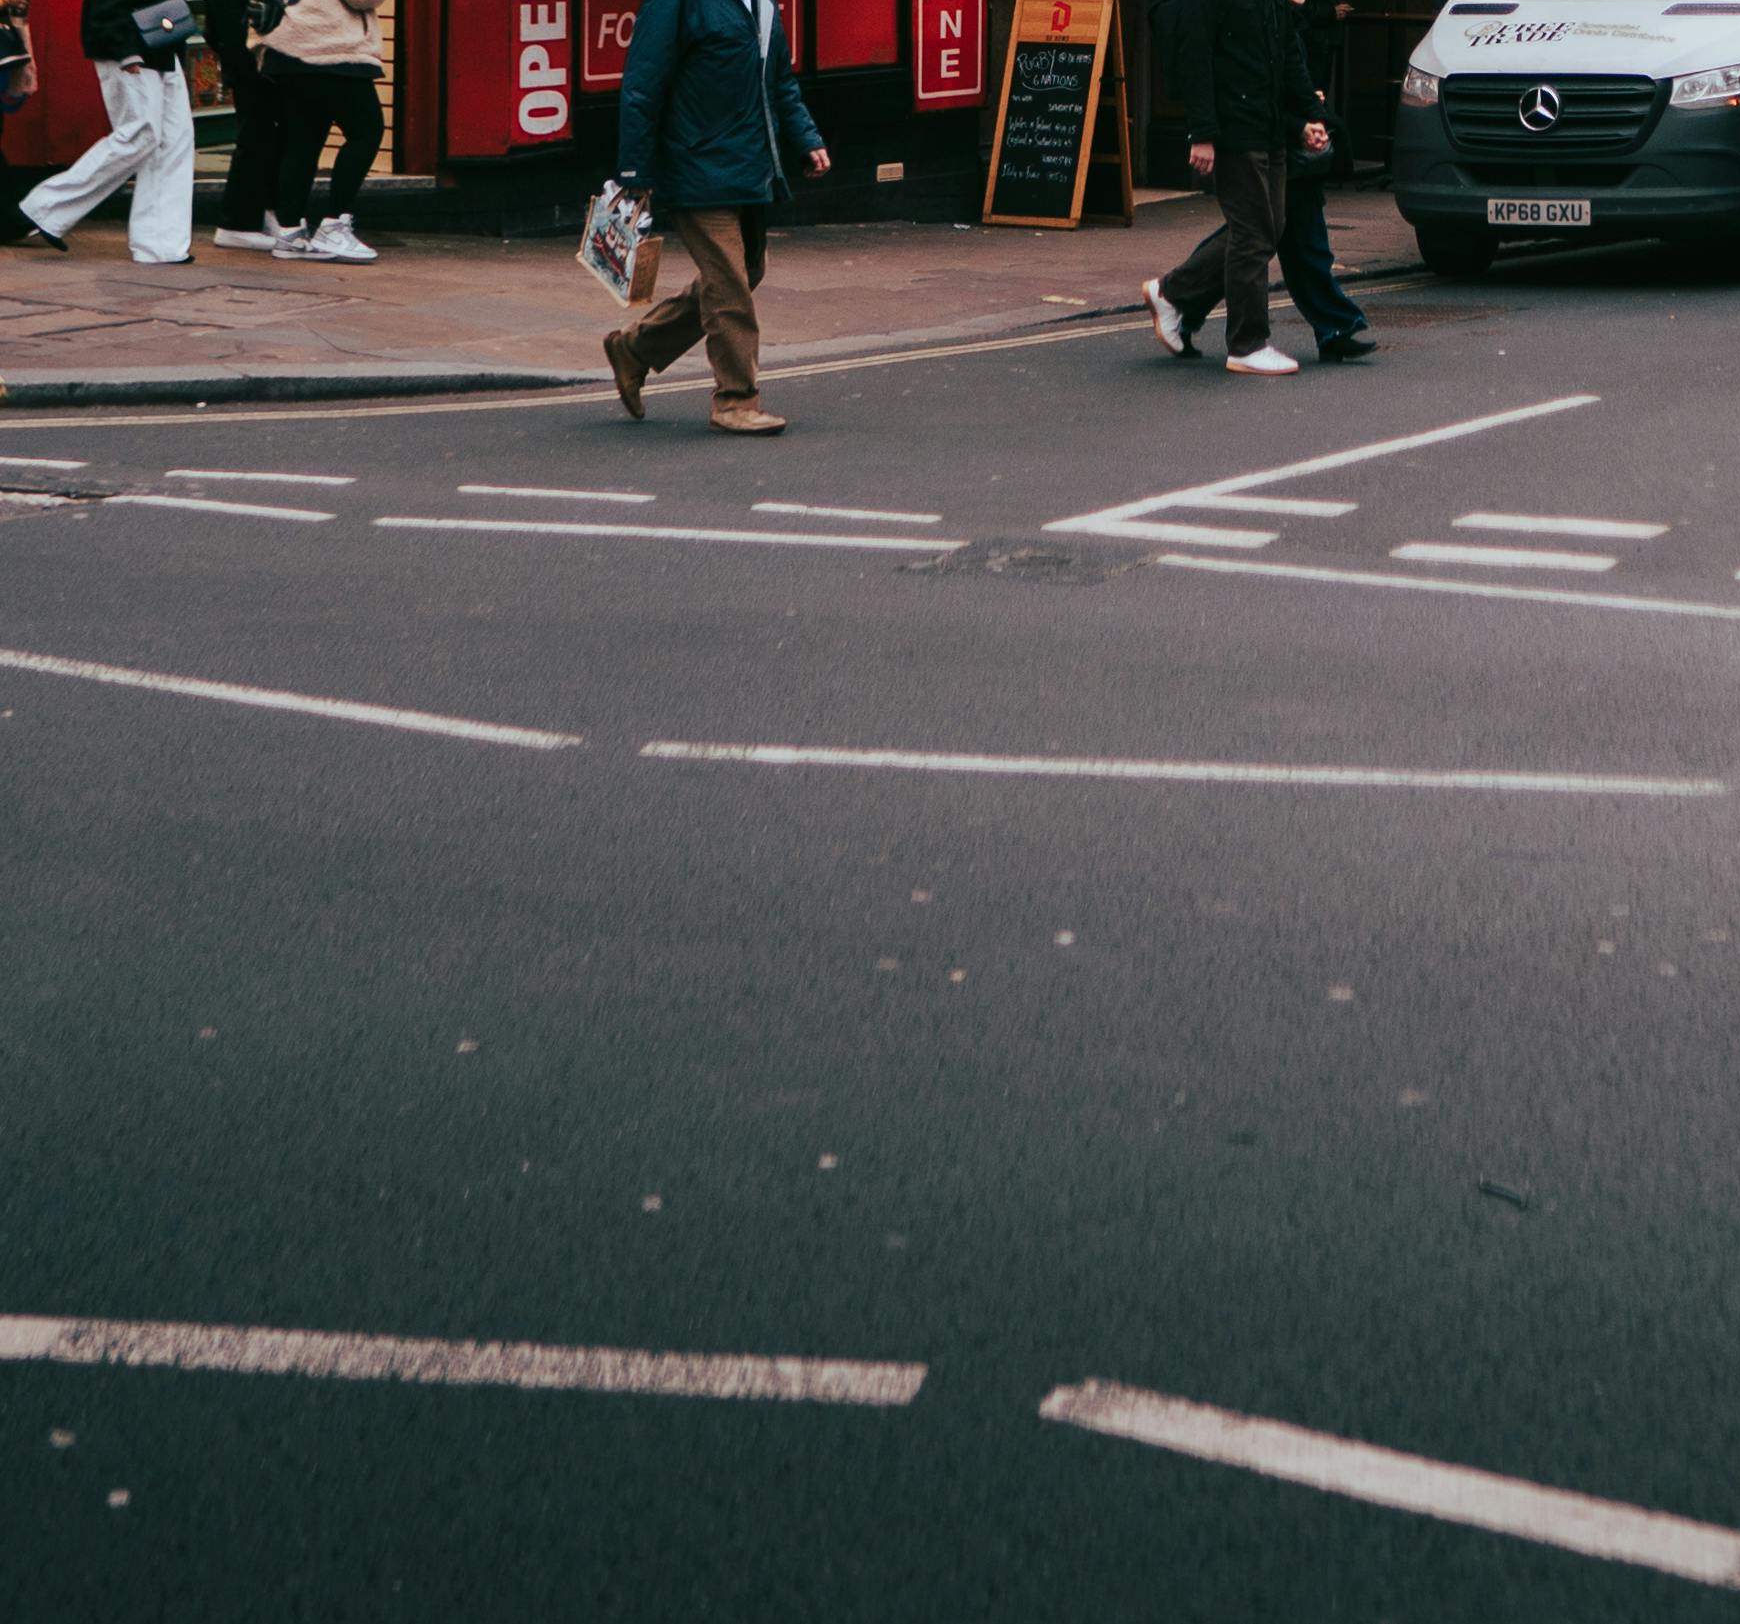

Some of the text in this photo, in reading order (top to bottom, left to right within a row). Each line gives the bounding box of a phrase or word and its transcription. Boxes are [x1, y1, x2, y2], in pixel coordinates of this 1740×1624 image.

[1497, 22, 1576, 34] FREE
[1469, 32, 1568, 47] TRADE
[1495, 202, 1583, 222] KP68 GXU
